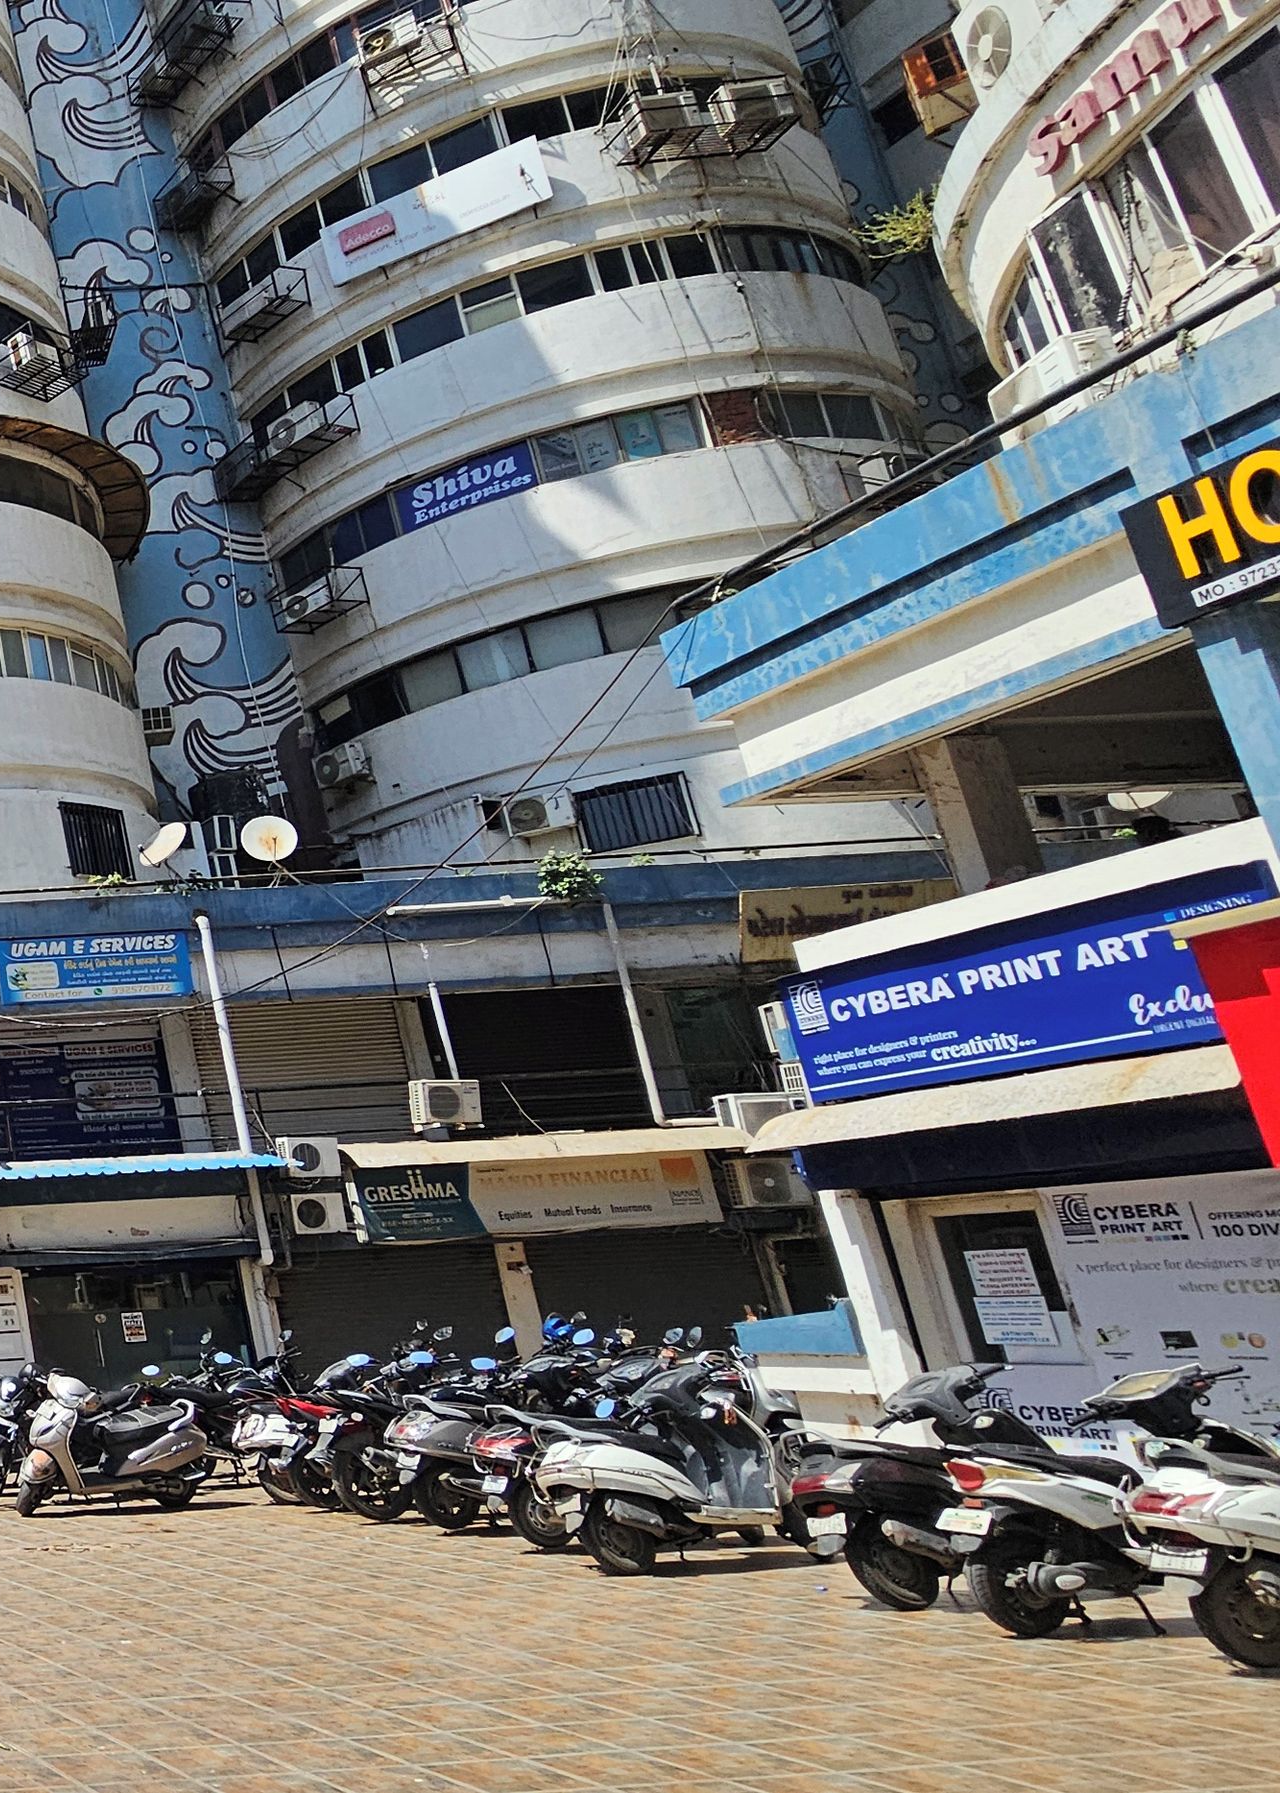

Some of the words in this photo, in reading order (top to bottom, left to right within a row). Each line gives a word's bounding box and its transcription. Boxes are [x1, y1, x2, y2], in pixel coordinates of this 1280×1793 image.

[346, 222, 391, 248] Adecco
[411, 455, 517, 509] Shiva
[415, 474, 533, 524] Enterprises
[1157, 450, 1280, 579] HO
[1198, 583, 1225, 603] MO
[1239, 560, 1280, 586] 9723
[11, 941, 66, 957] UGAM
[73, 940, 85, 954] E
[90, 934, 176, 954] SERVICES
[830, 976, 956, 1022] CYBERA
[957, 950, 1062, 995] PRINT
[1077, 930, 1150, 971] ART
[25, 989, 69, 1000] Contact
[814, 1053, 834, 1066] right
[834, 1049, 854, 1063] place
[855, 1046, 867, 1058] for
[868, 1038, 909, 1054] designers
[919, 1030, 958, 1046] printers
[817, 1064, 840, 1076] where
[841, 1063, 857, 1075] you
[859, 1059, 873, 1069] can
[873, 1053, 906, 1067] express
[906, 1049, 927, 1063] your
[931, 1032, 1037, 1061] creativity...
[364, 1174, 460, 1202] GRESHMA
[499, 1210, 533, 1221] Equities
[544, 1206, 573, 1217] Mutual
[576, 1205, 601, 1216] Funds
[610, 1203, 653, 1214] Insurance
[1094, 1202, 1180, 1220] CYBERA
[1100, 1222, 1145, 1234] PRINT
[1152, 1221, 1184, 1231] ART
[1212, 1224, 1244, 1238] 100
[1248, 1222, 1280, 1237] DIV
[1086, 1260, 1127, 1275] perfect
[1130, 1259, 1161, 1273] place
[1165, 1258, 1182, 1270] for
[1185, 1257, 1248, 1271] designers
[1179, 1282, 1218, 1292] where
[1019, 1405, 1108, 1424] CYBER
[1034, 1425, 1074, 1437] RINT
[1079, 1426, 1112, 1440] ART
